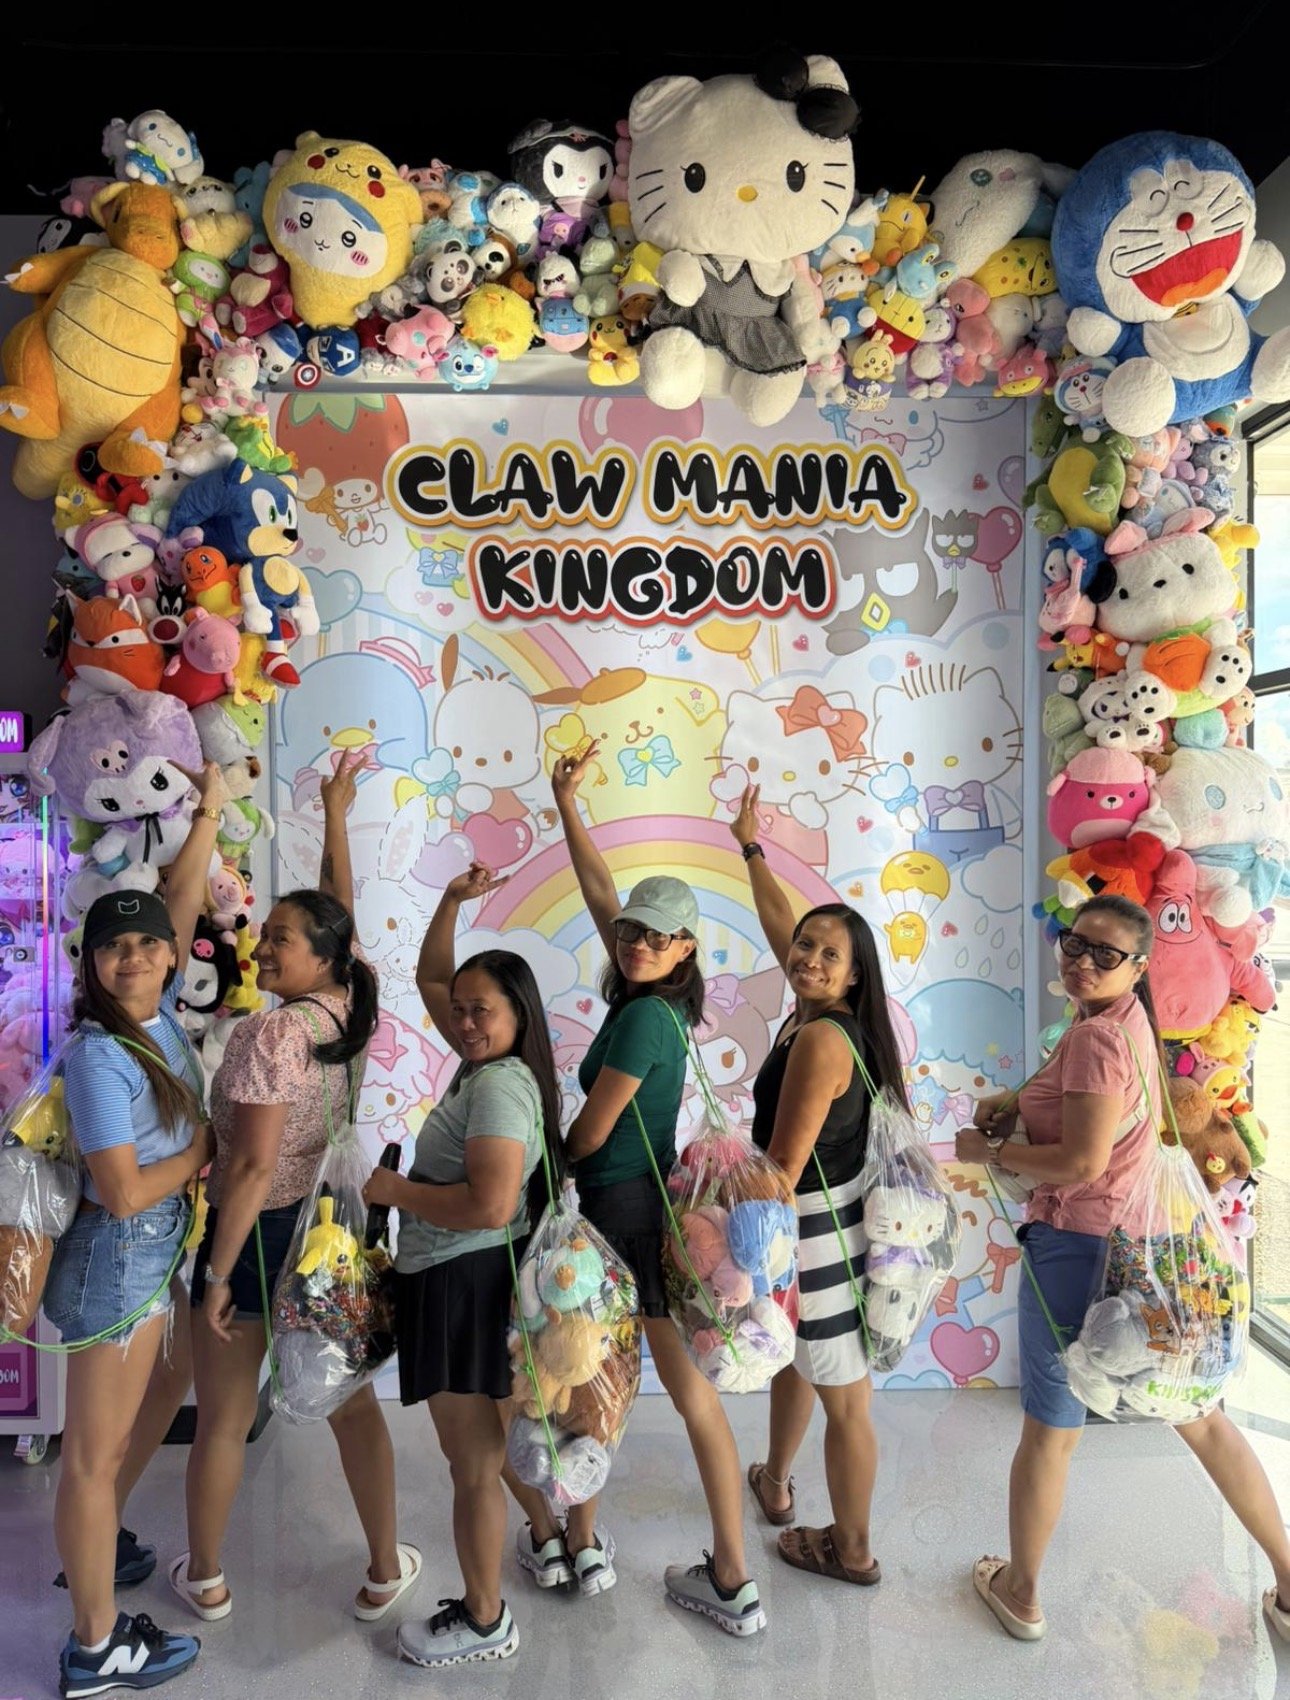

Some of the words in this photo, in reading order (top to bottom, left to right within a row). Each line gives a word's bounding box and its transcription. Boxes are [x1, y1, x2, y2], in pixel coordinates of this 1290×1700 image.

[398, 448, 625, 518] CLAW
[653, 451, 907, 519] MANIA
[479, 545, 827, 616] KINGDOM
